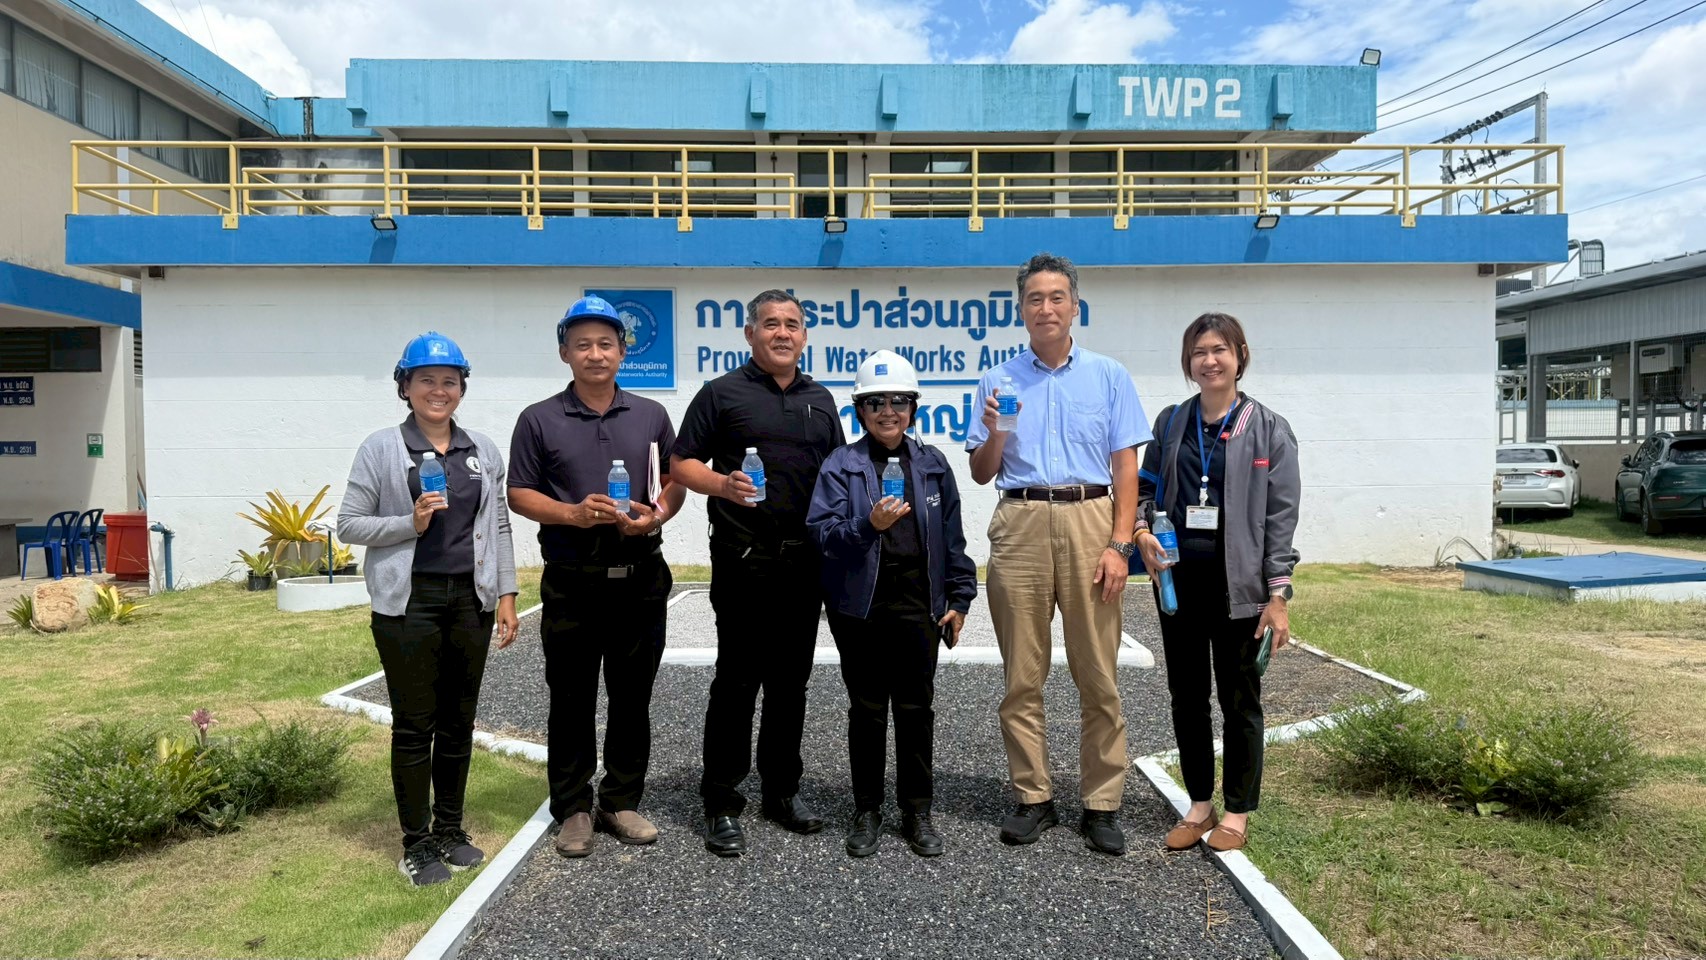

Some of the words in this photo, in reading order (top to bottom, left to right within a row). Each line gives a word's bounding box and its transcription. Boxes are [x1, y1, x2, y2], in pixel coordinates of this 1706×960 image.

[1118, 76, 1208, 117] TWP
[1215, 78, 1241, 118] 2
[825, 346, 878, 373] Wat
